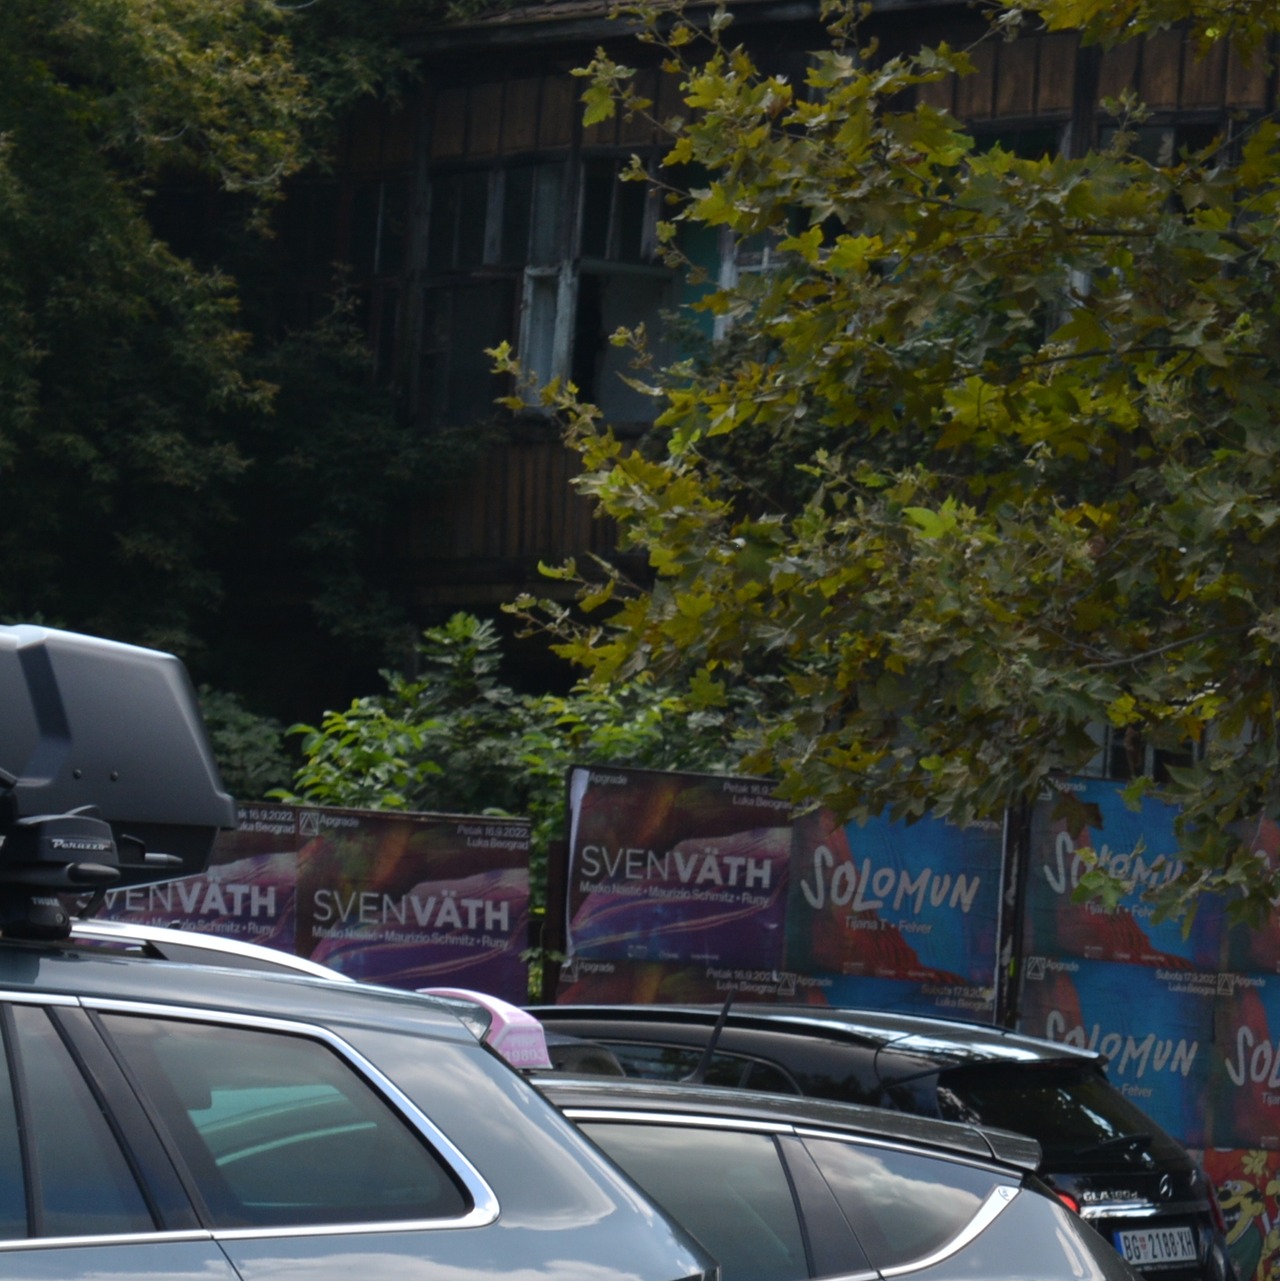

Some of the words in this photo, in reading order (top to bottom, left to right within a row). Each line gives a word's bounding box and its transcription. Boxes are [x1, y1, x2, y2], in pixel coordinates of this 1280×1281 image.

[467, 838, 489, 848] Luka
[800, 845, 981, 914] SOLOMUN
[1188, 984, 1216, 995] Beogra
[1123, 1234, 1141, 1261] BG
